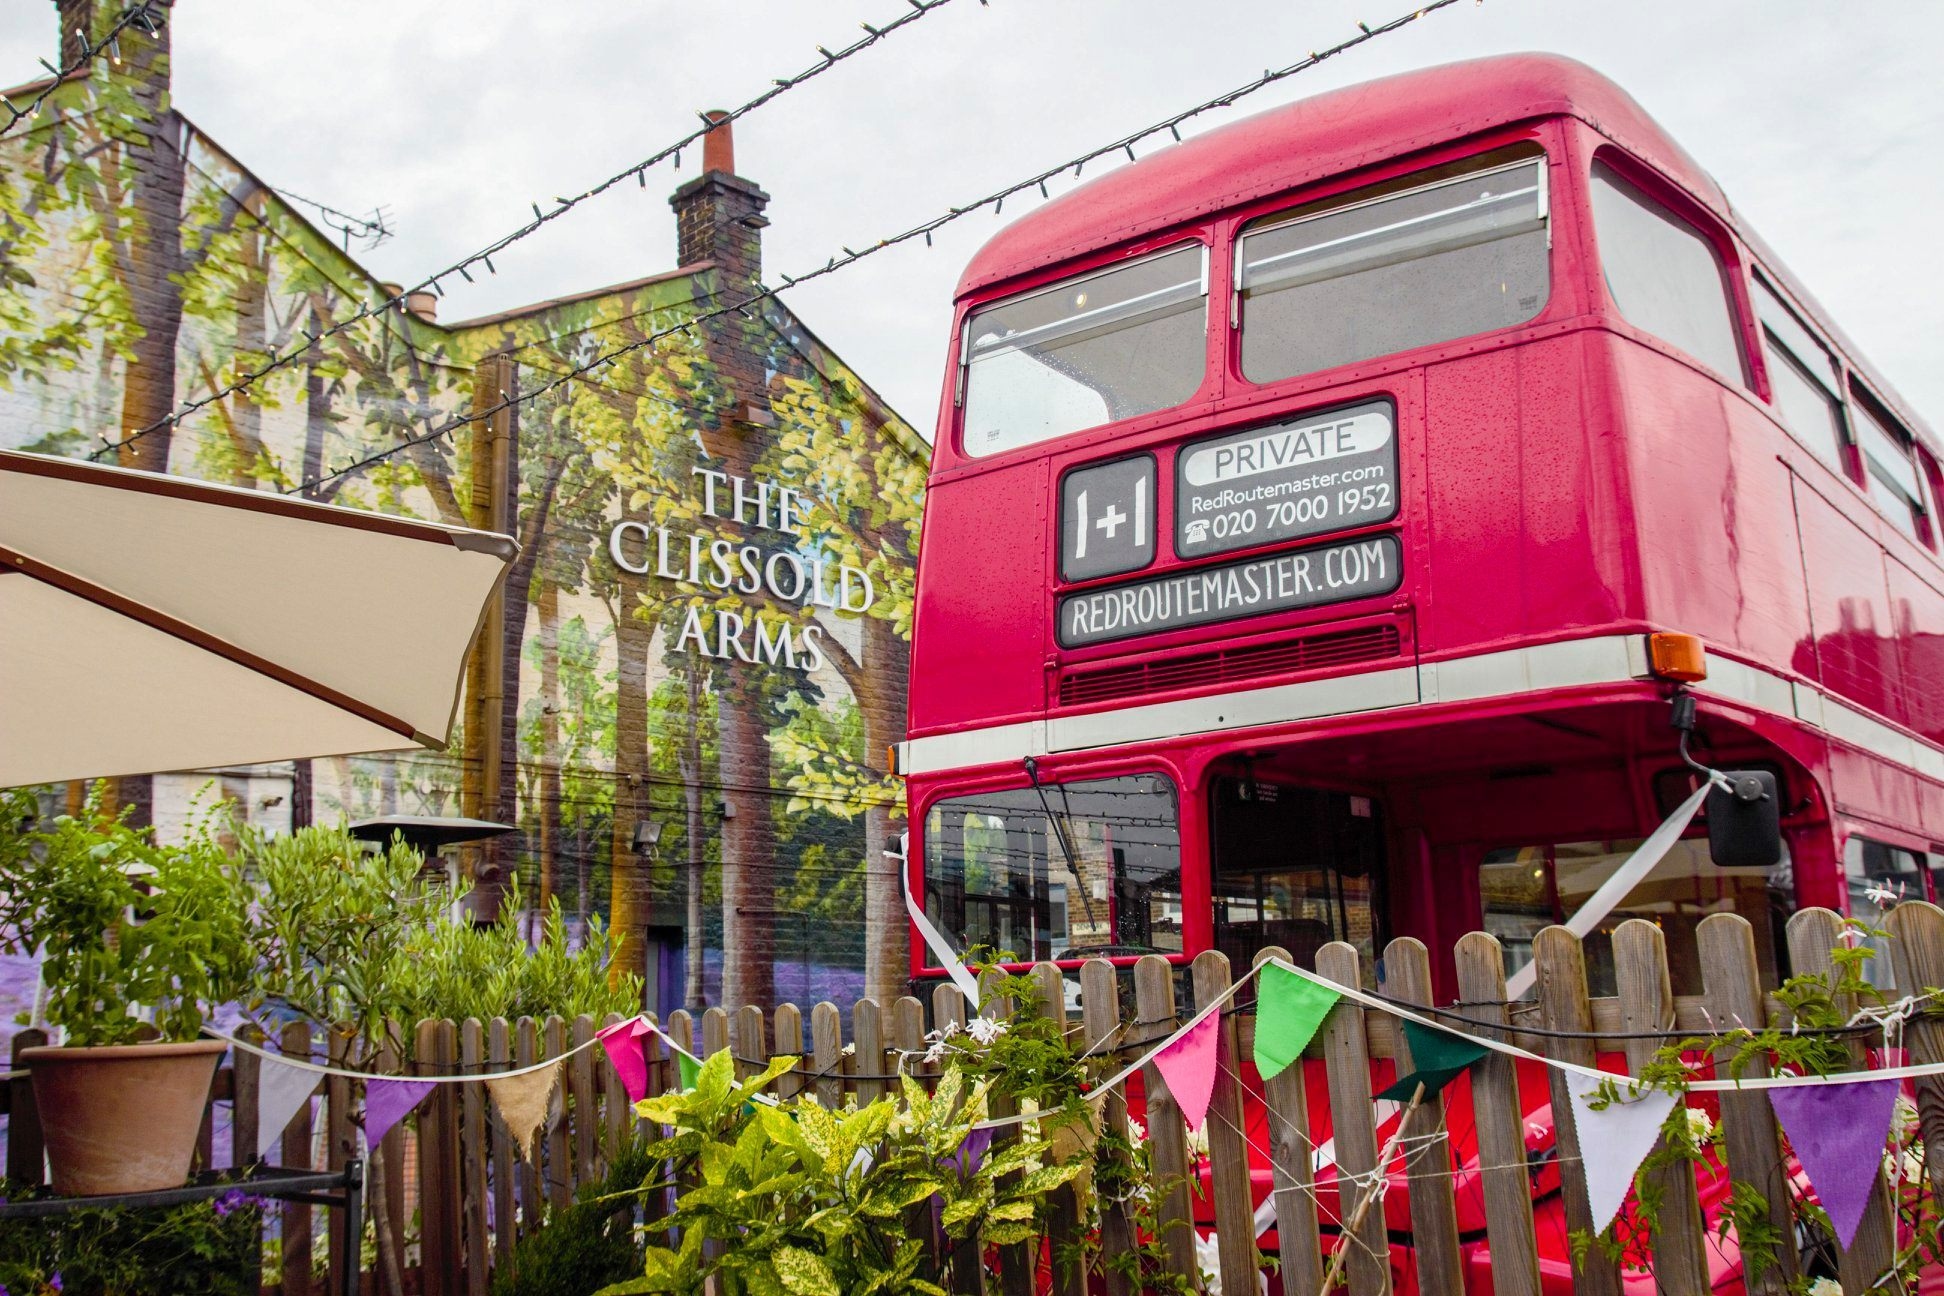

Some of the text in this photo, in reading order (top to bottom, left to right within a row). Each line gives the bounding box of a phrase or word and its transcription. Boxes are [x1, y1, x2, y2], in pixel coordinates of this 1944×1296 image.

[1215, 421, 1356, 479] PRIVATE
[691, 465, 811, 535] THE
[1075, 475, 1147, 559] 1+1
[1191, 465, 1384, 514] RedRoutemaster.com
[1212, 482, 1391, 539] 020 7000 1952
[608, 521, 874, 614] CLISSOLD
[1071, 539, 1386, 637] REDROUTEMASTER.COM
[671, 604, 824, 673] ARMS
